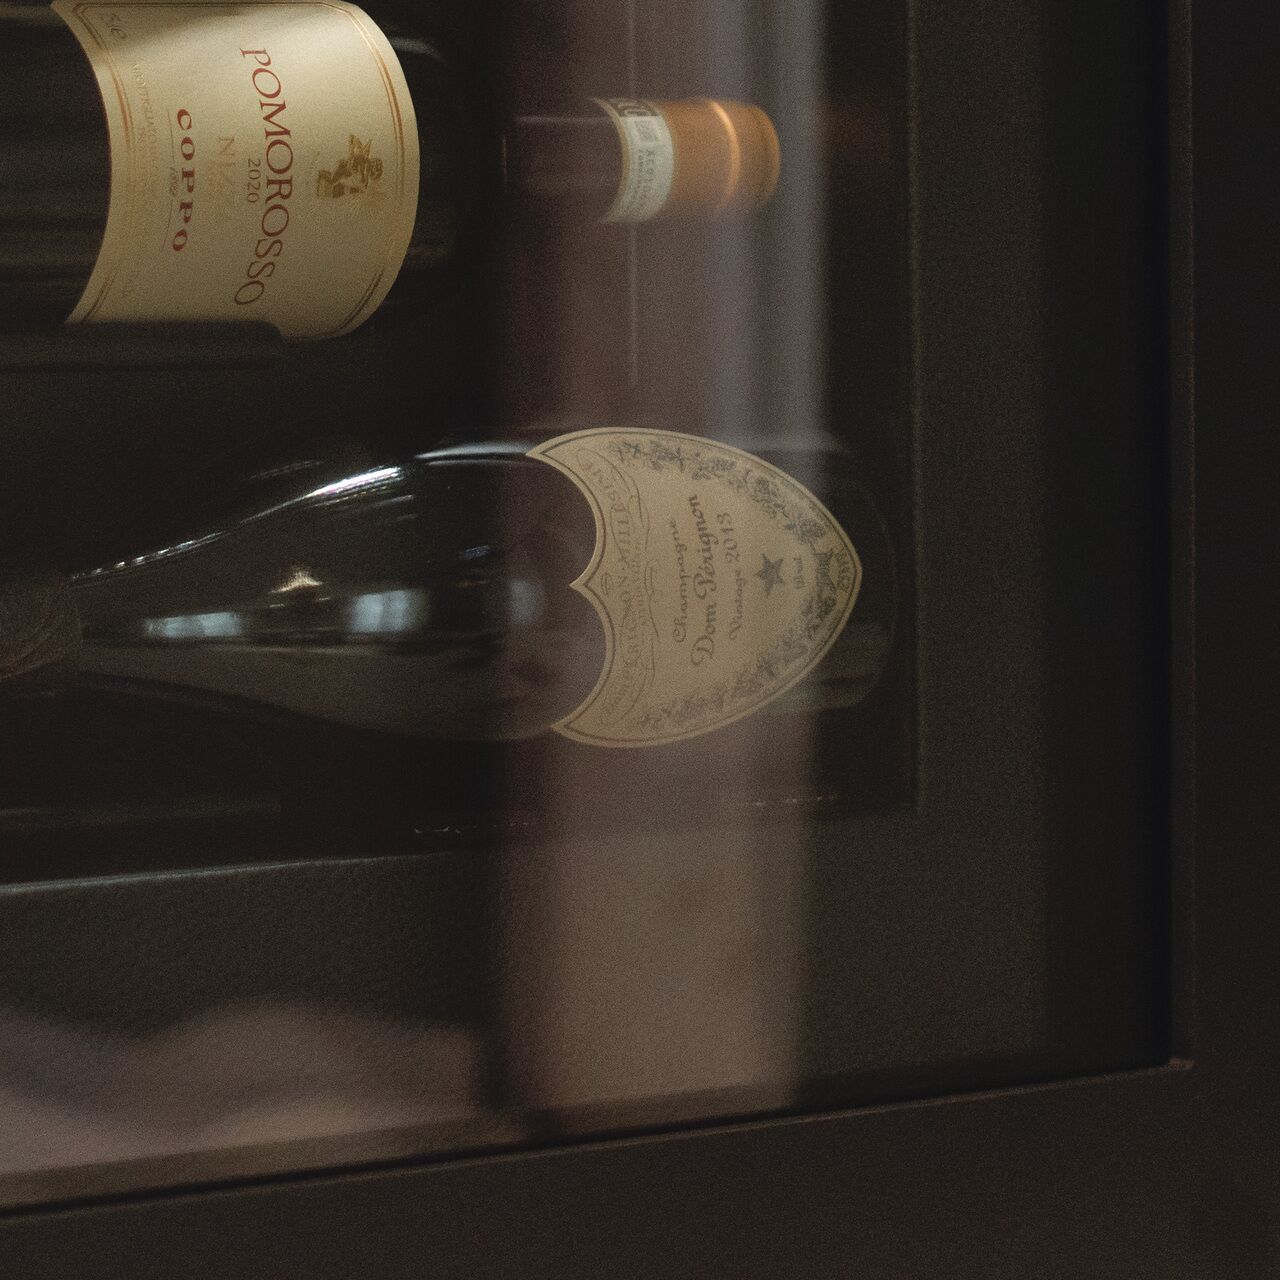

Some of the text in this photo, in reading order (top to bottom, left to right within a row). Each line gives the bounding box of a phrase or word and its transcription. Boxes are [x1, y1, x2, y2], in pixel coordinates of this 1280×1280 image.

[171, 107, 196, 252] COPPO
[234, 46, 295, 306] POMOROSSO
[246, 156, 262, 204] 2020
[668, 518, 690, 644] Champagne
[687, 493, 720, 667] Dom Pérignon
[716, 512, 748, 641] Vintage 2013
